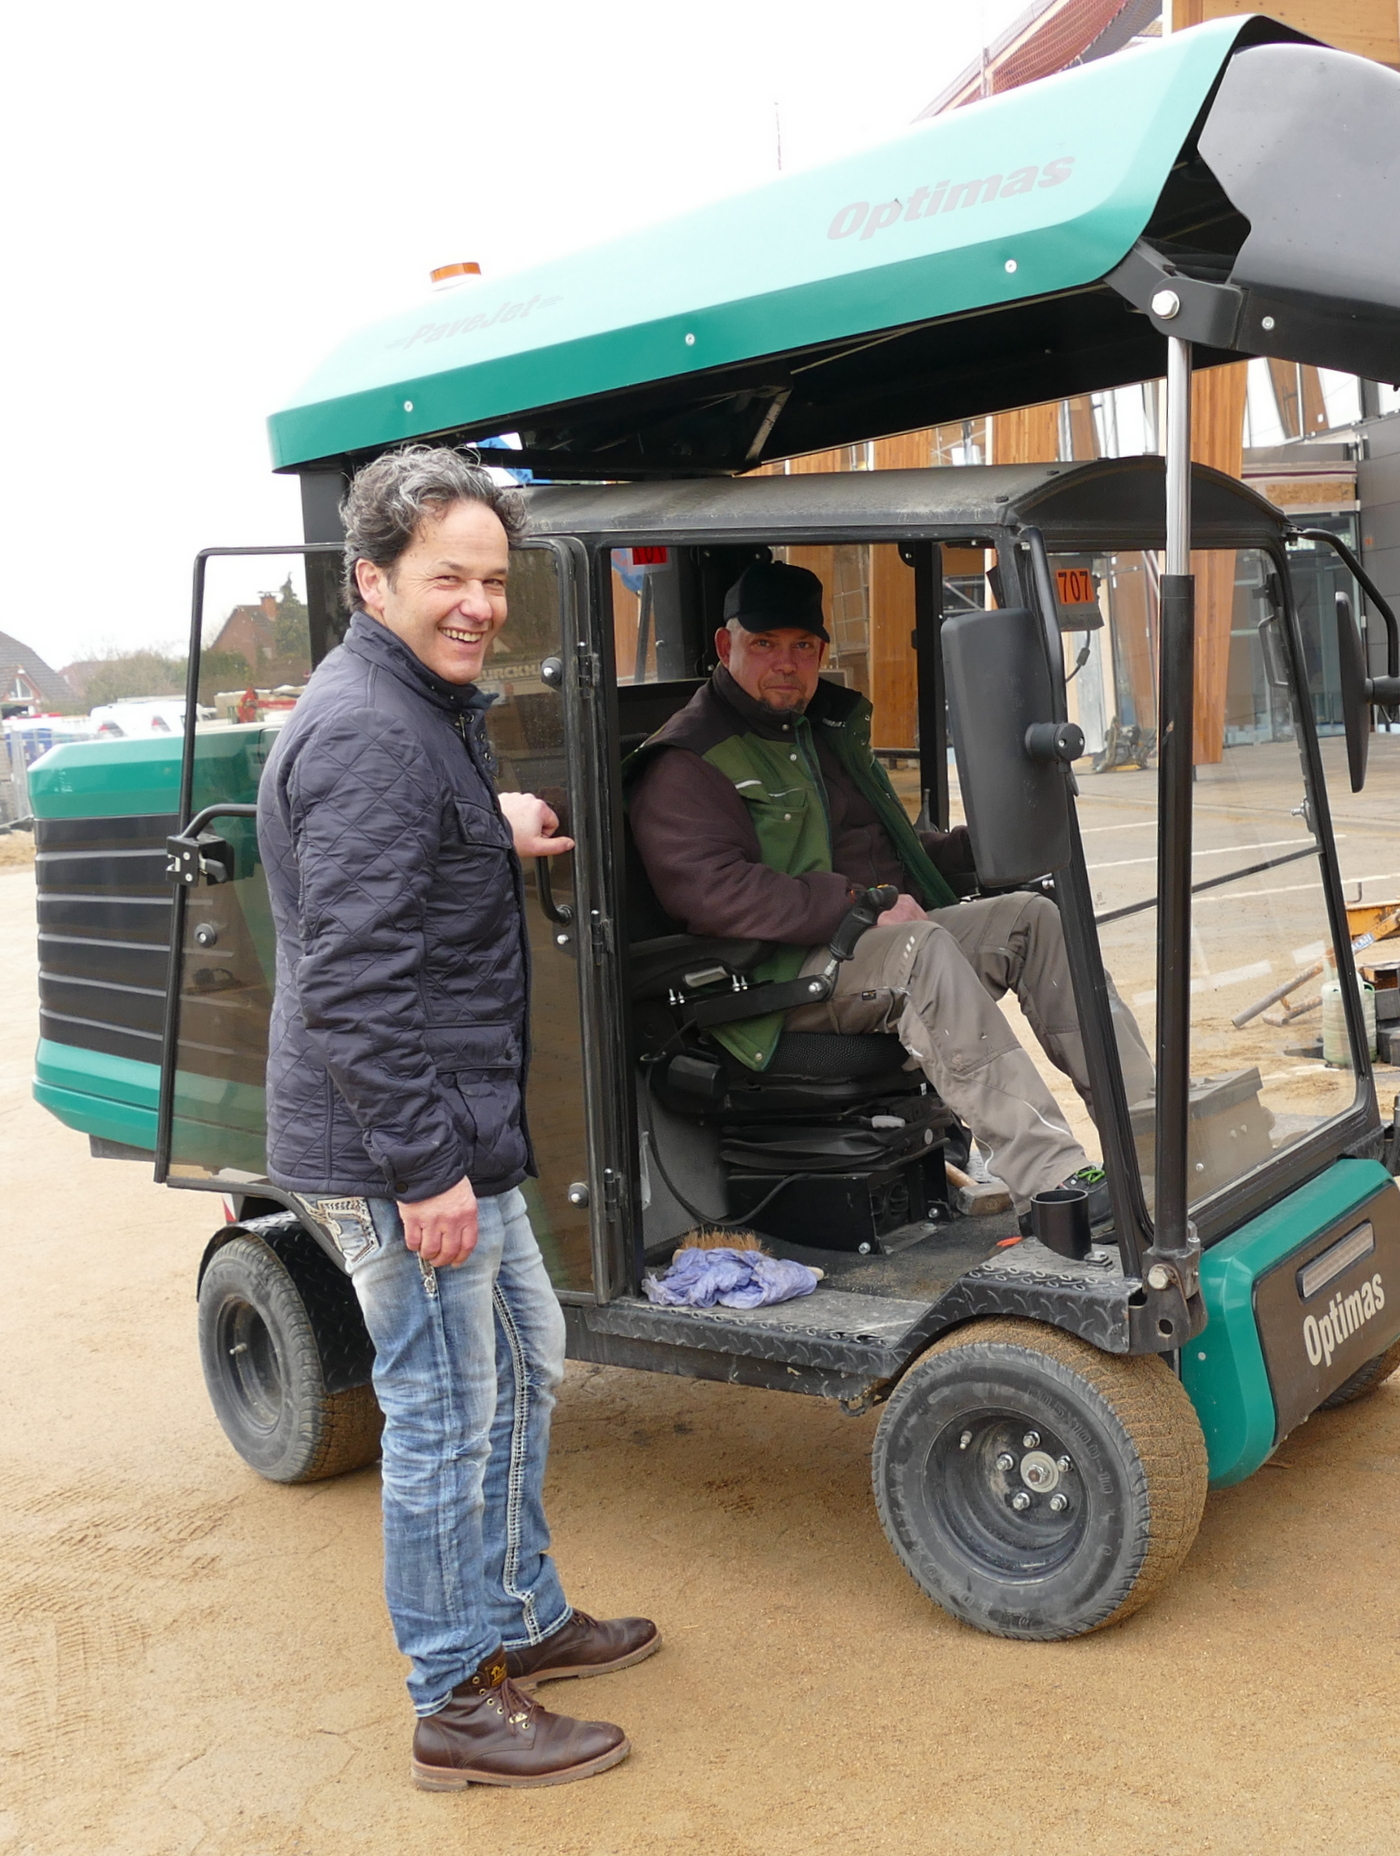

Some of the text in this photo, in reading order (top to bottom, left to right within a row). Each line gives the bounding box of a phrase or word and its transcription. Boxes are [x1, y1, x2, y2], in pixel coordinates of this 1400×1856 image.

[826, 156, 1076, 241] Optimas
[402, 294, 542, 350] PaveJet
[1057, 570, 1088, 603] 707
[1303, 1273, 1385, 1368] Optimas
